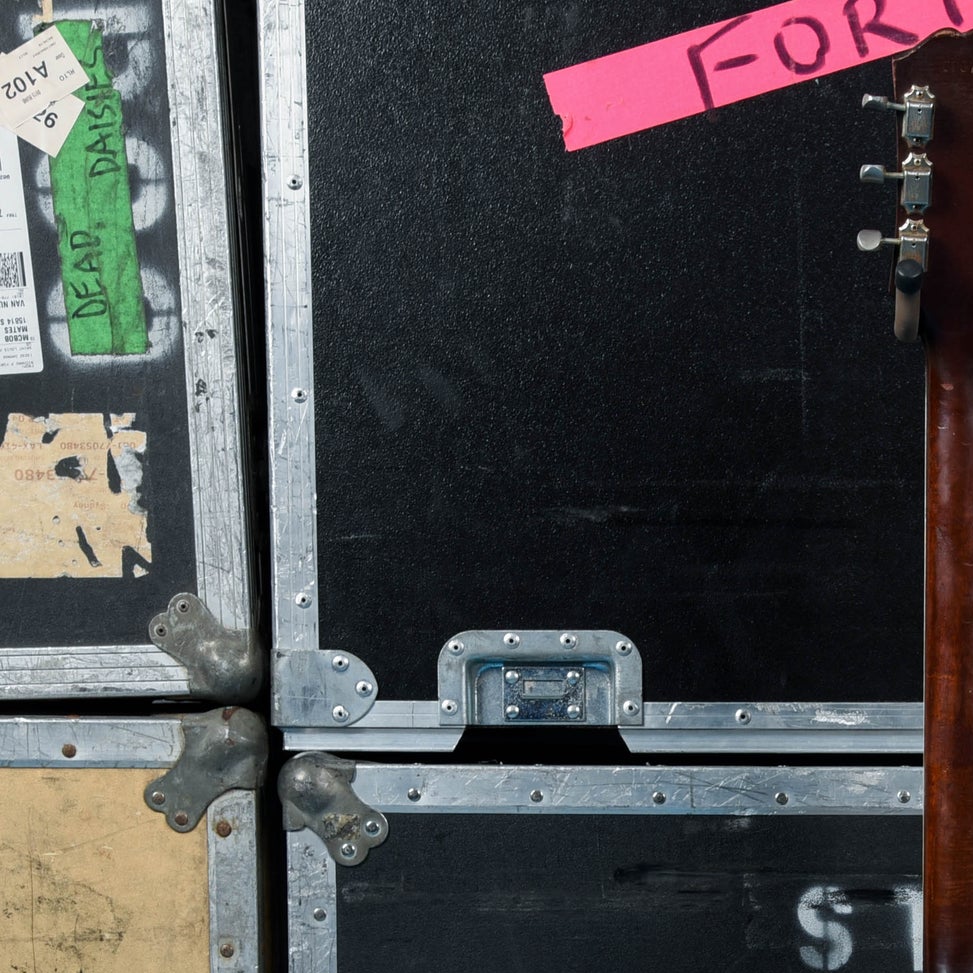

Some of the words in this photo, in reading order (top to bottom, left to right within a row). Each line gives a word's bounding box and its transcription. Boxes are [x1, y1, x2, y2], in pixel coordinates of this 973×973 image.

[1, 60, 49, 100] A102
[70, 230, 108, 320] DEAD
[4, 325, 28, 334] MATES
